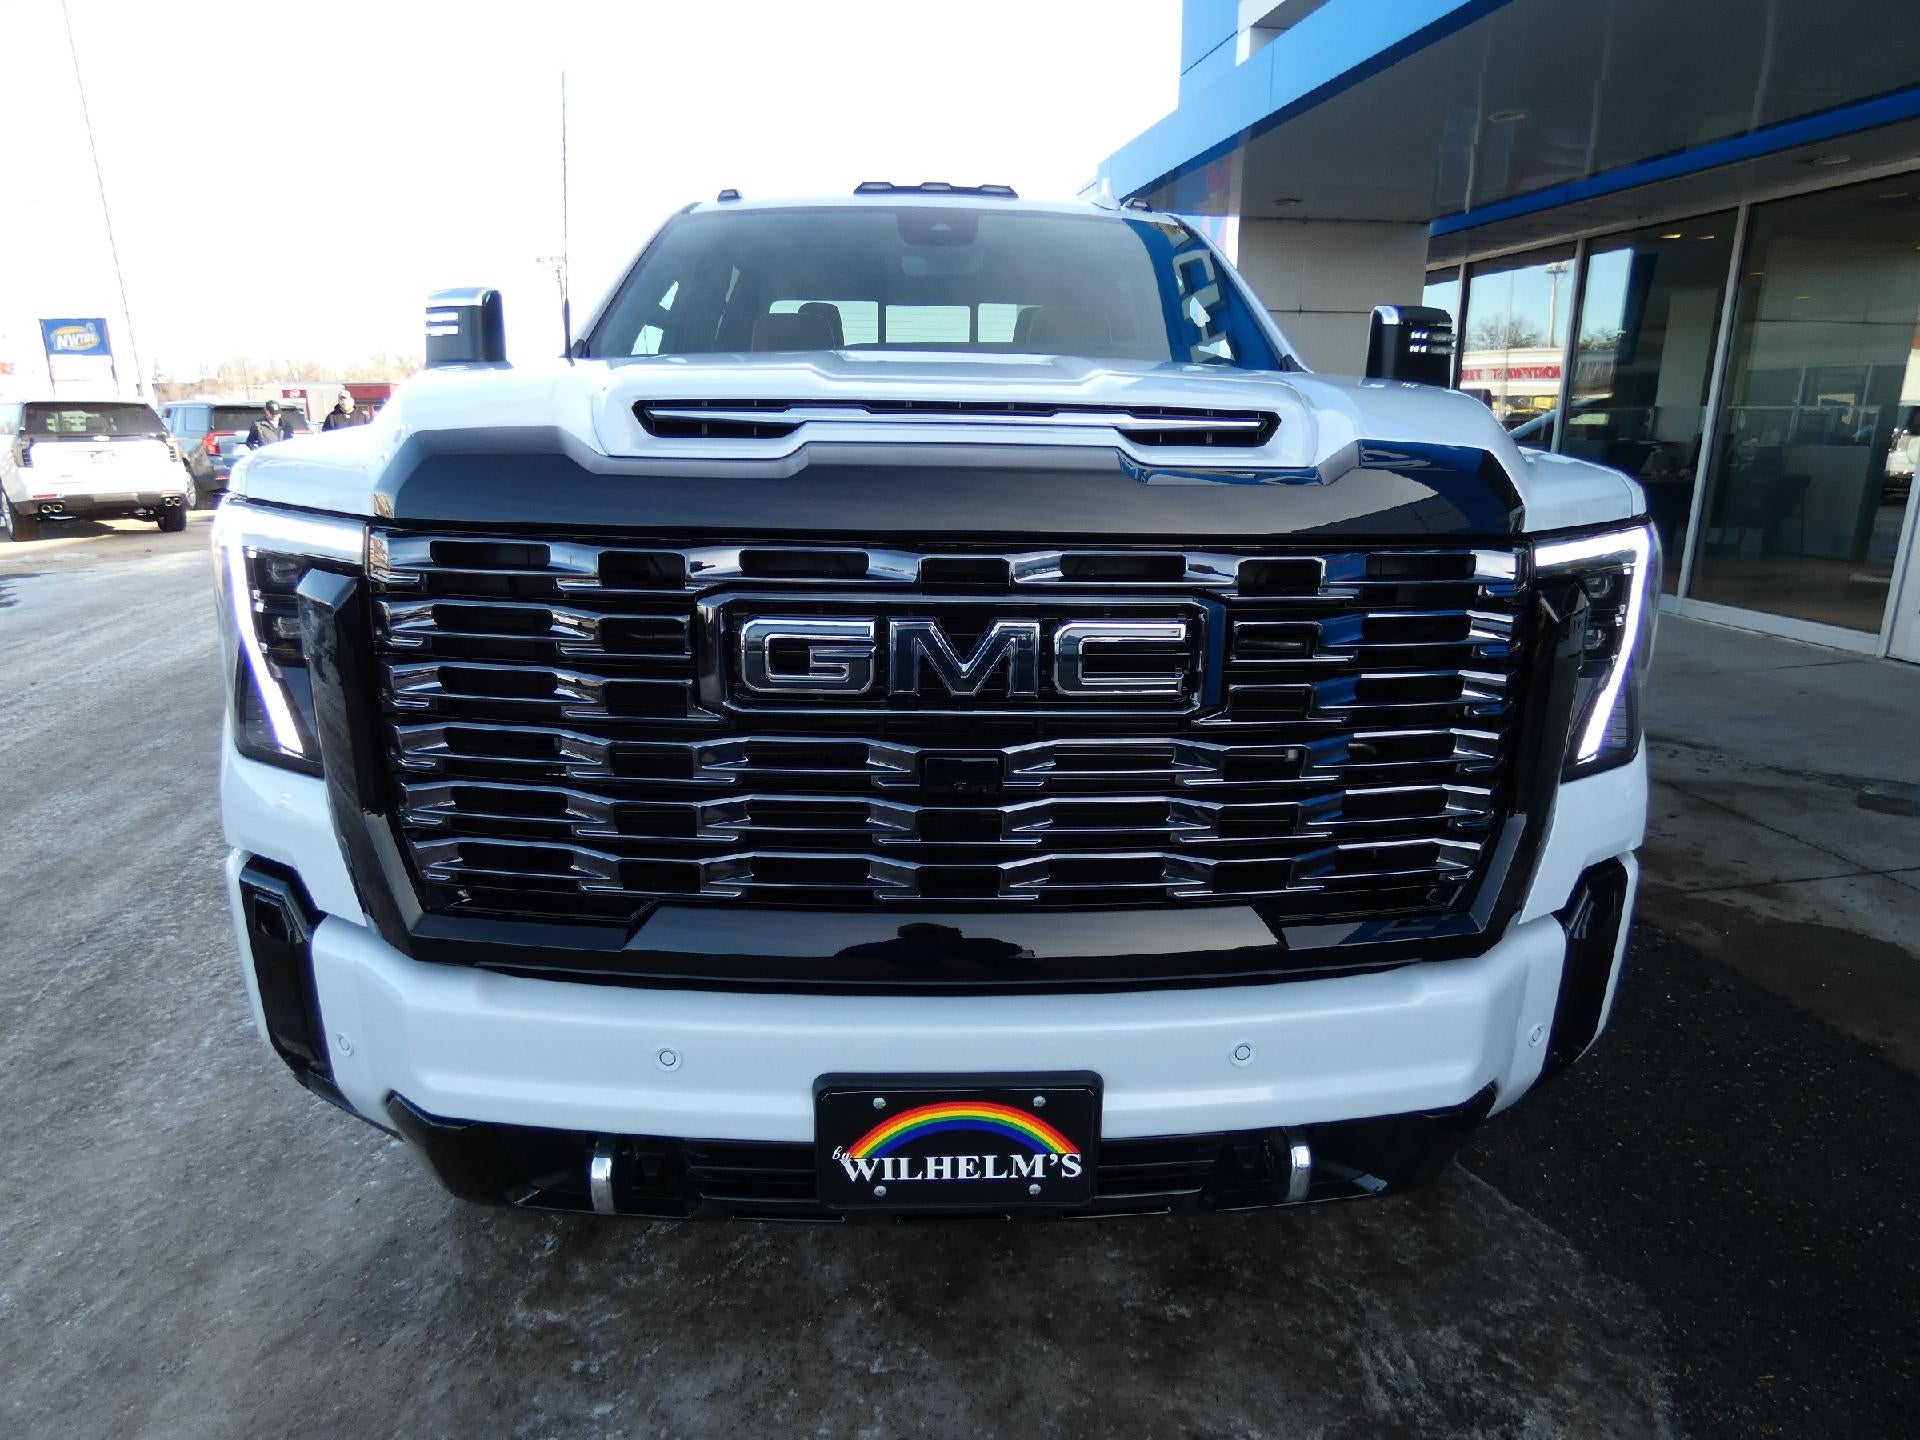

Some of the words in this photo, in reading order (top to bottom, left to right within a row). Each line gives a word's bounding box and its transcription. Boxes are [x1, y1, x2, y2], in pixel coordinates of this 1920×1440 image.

[740, 616, 1188, 698] GMC
[832, 1146, 851, 1163] by
[841, 1153, 1082, 1182] WILHELM'S
